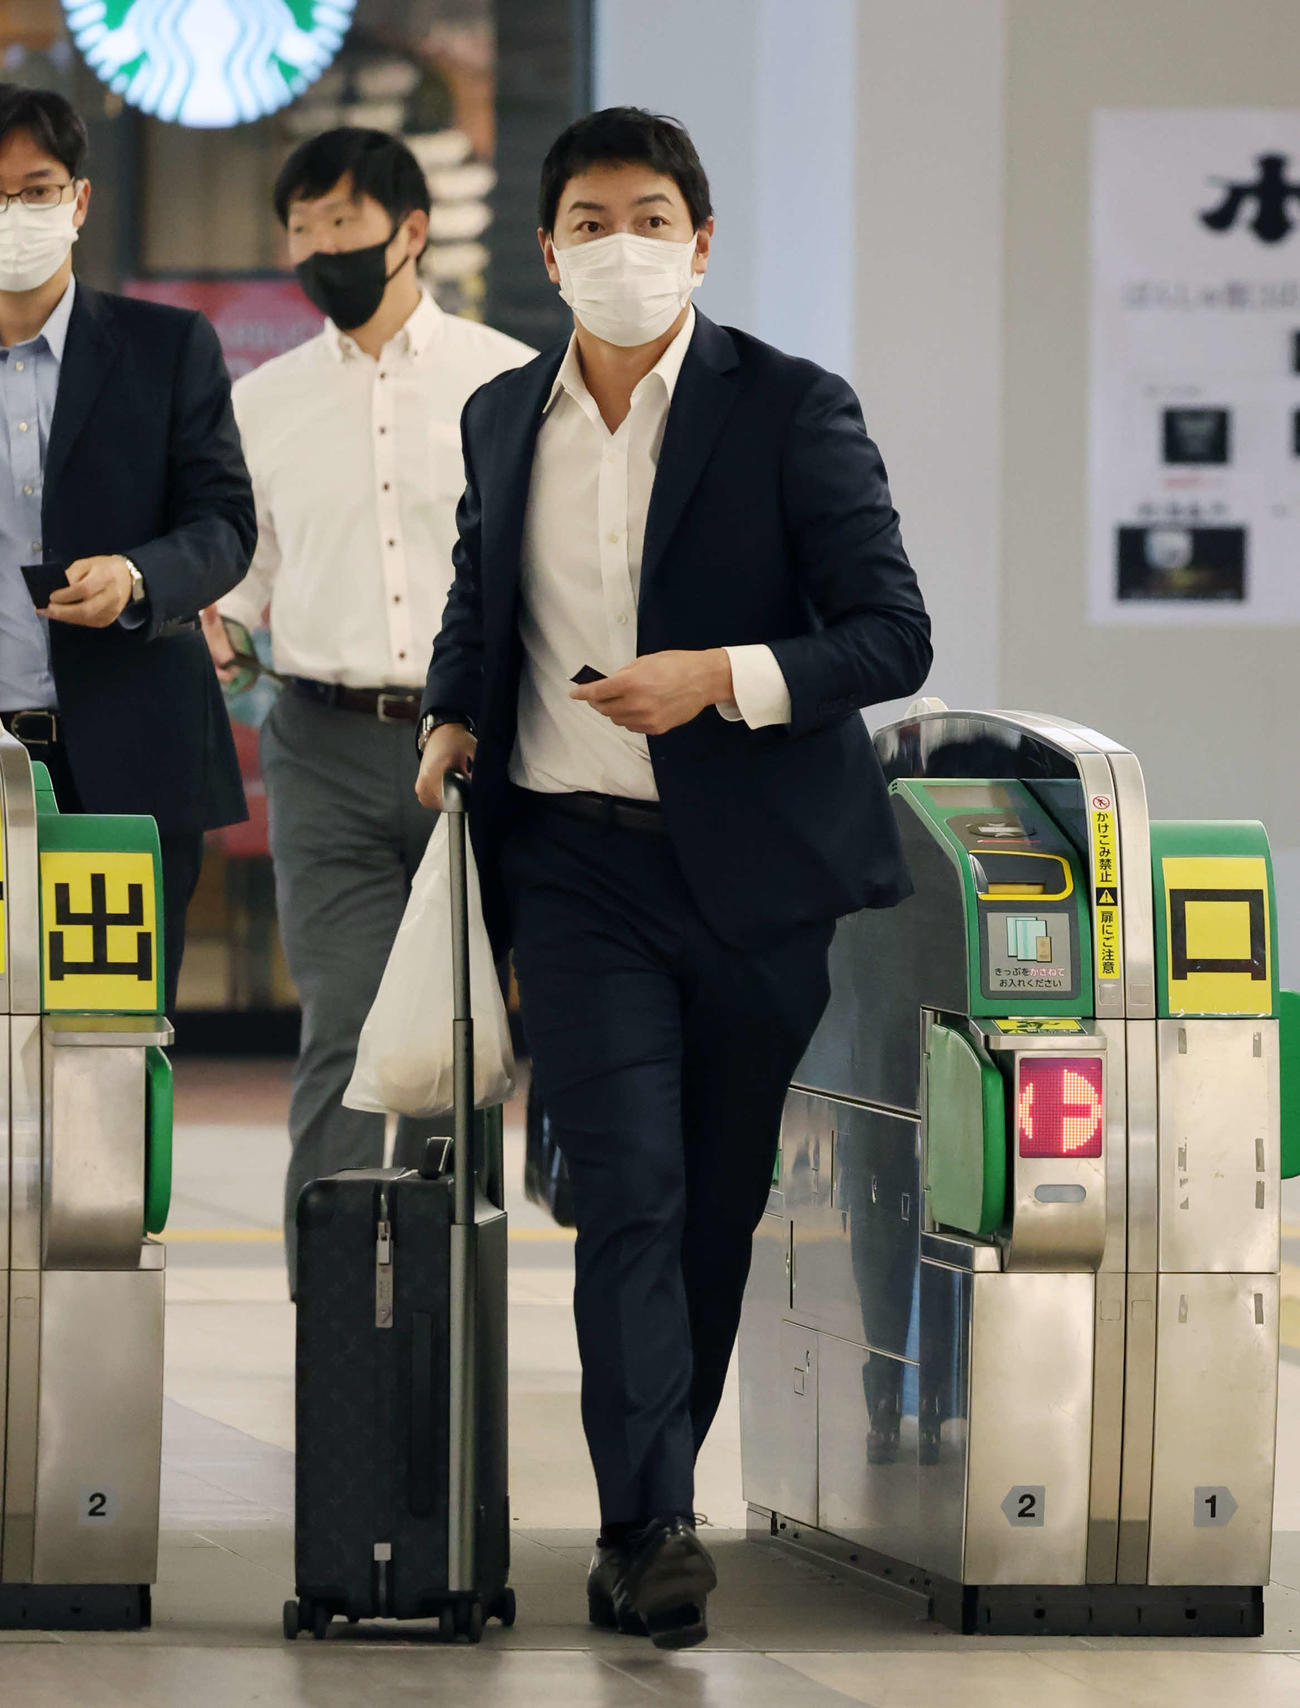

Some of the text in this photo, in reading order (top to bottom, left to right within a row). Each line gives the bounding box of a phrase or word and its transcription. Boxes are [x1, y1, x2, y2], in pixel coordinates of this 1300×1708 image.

[1097, 811, 1113, 883] かけこみ禁止
[49, 873, 152, 981] 出
[1100, 910, 1115, 974] 扉にご注意
[1169, 889, 1266, 980] 口
[999, 979, 1062, 988] お入れください
[88, 1492, 106, 1517] 2
[1017, 1494, 1036, 1518] 2
[1204, 1494, 1217, 1518] 1
